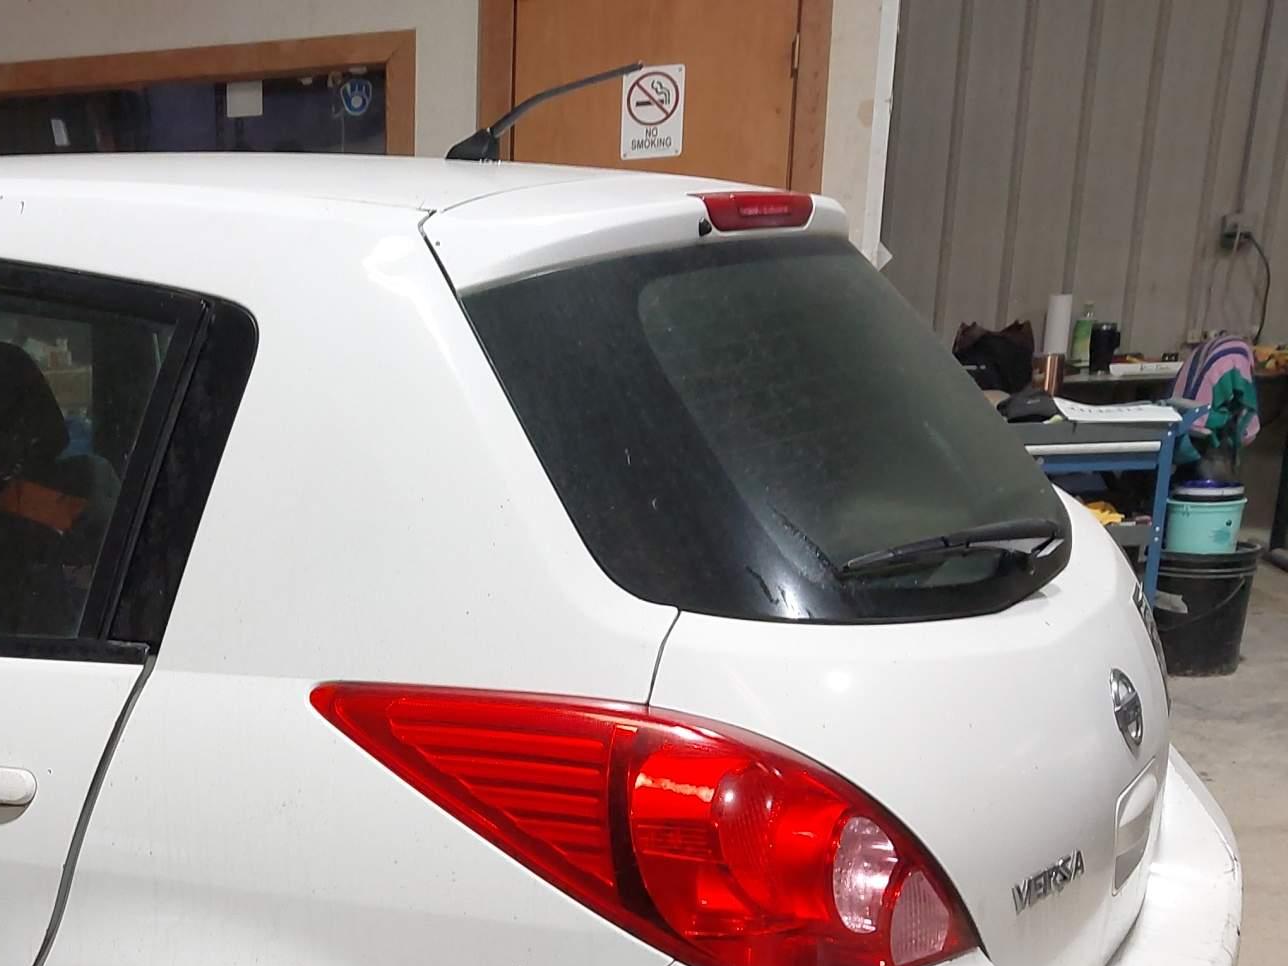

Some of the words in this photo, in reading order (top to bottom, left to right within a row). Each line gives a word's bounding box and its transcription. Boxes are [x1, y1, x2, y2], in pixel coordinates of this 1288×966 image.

[645, 126, 658, 138] NO
[631, 136, 672, 151] SMOKING
[1011, 848, 1085, 914] VERSA
